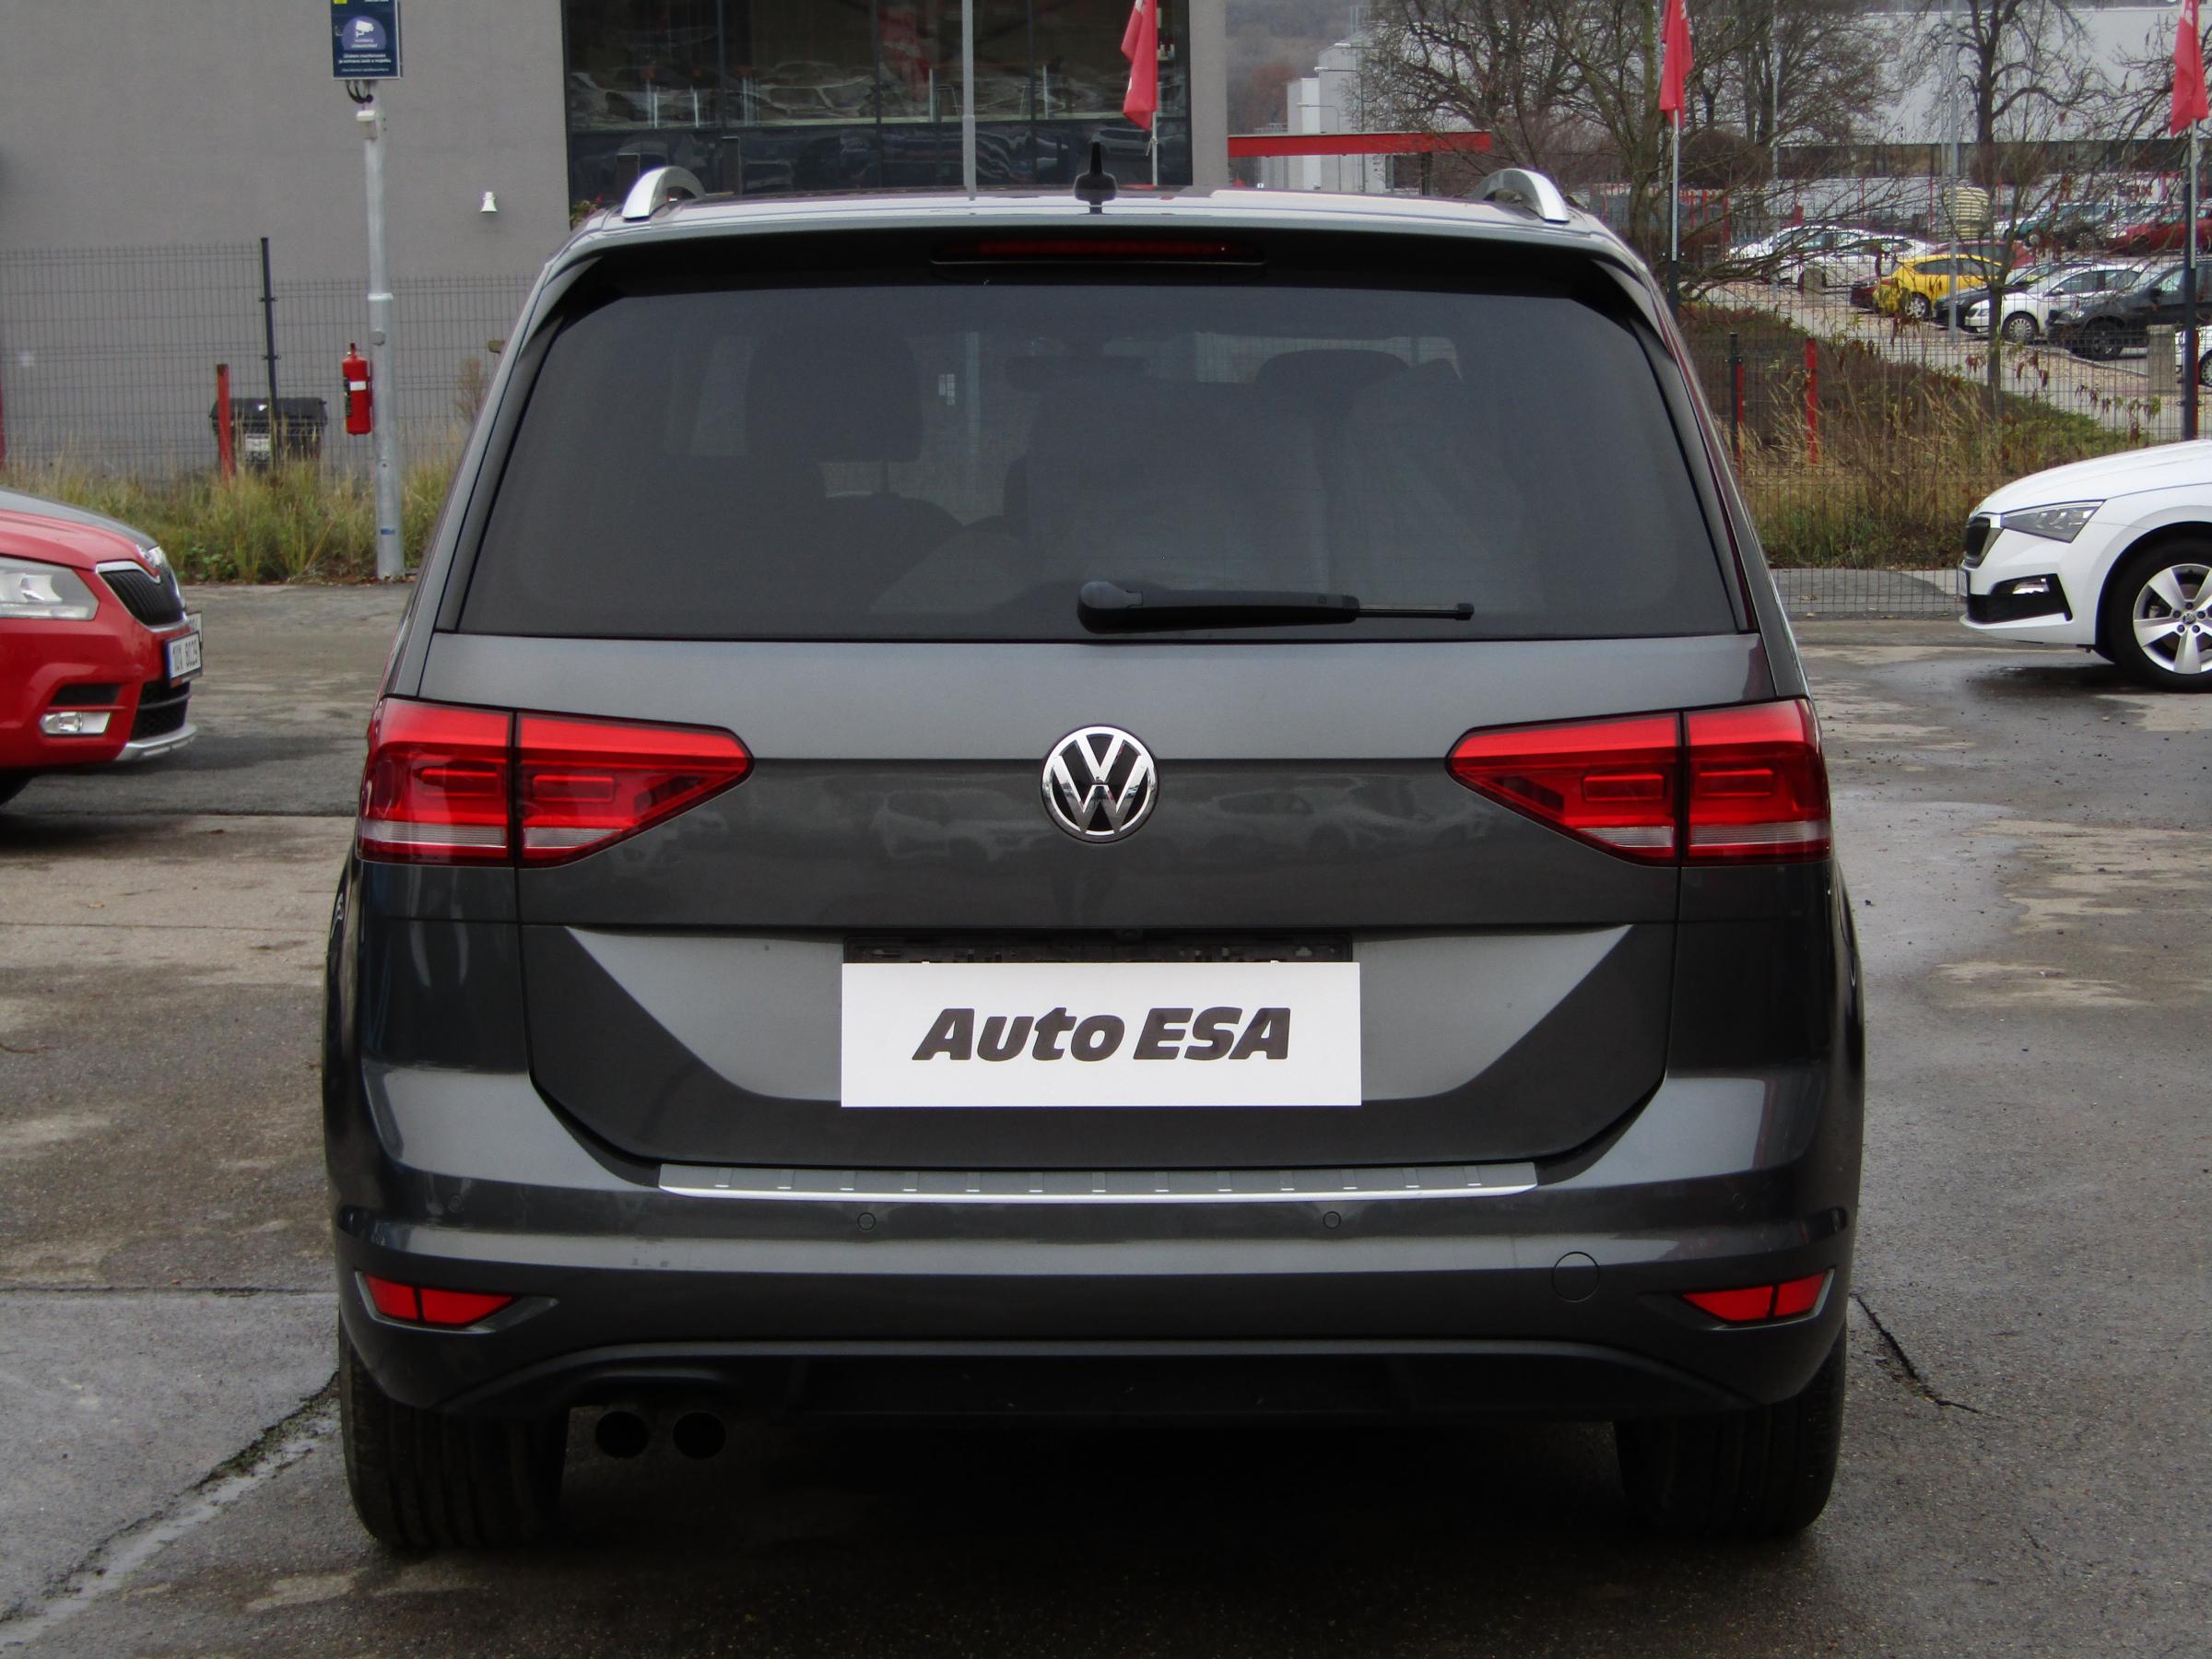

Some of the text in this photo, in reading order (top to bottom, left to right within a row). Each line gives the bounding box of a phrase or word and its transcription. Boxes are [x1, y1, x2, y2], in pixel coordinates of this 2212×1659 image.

[1045, 728, 1156, 840] VW
[912, 1006, 1291, 1062] Auto ESA
